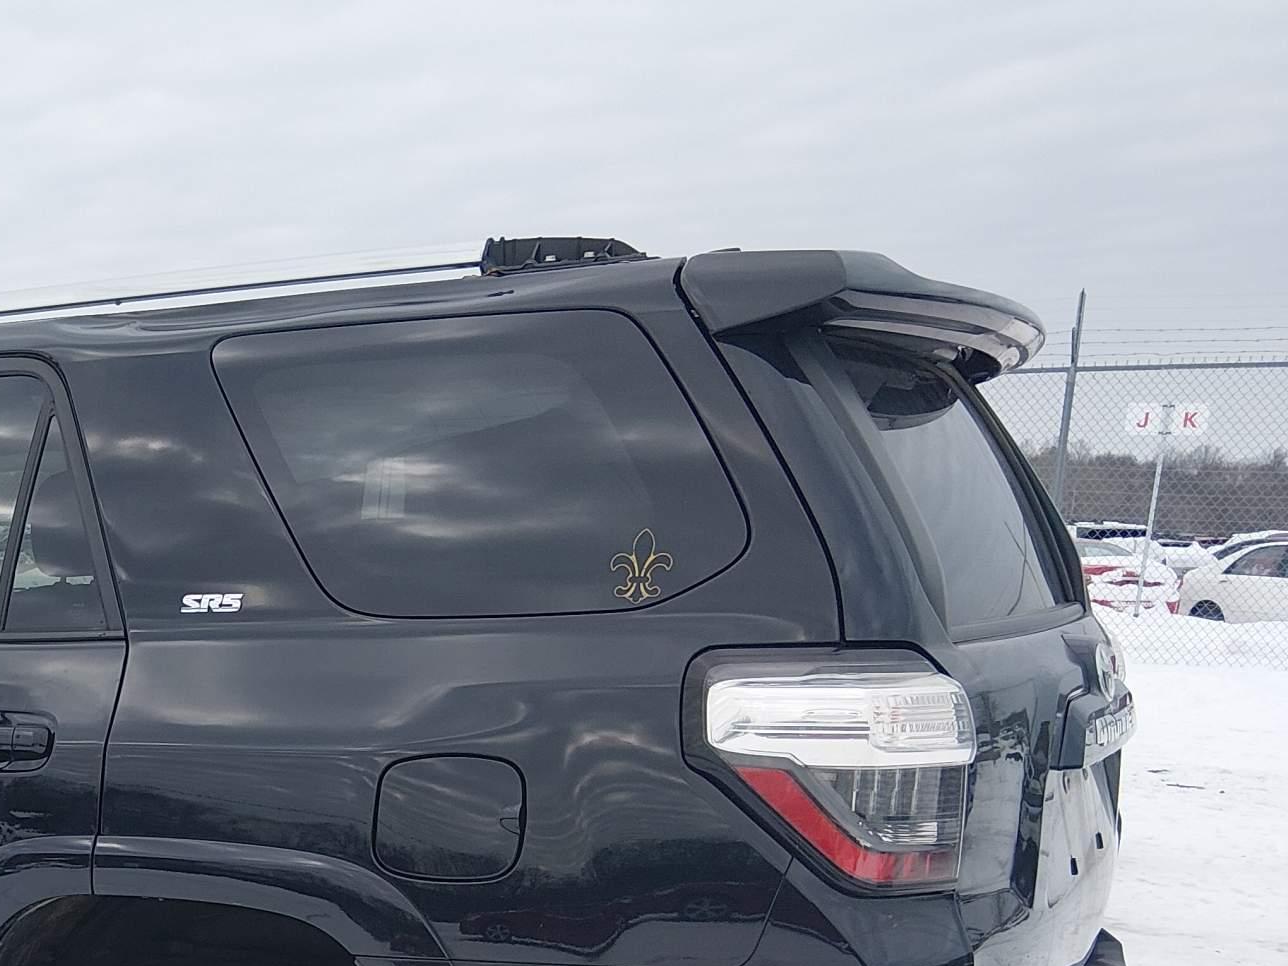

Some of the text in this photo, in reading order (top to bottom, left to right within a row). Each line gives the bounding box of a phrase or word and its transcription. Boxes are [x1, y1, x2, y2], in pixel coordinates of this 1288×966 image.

[1136, 411, 1150, 428] J
[1182, 411, 1199, 428] K
[180, 593, 244, 613] SR5
